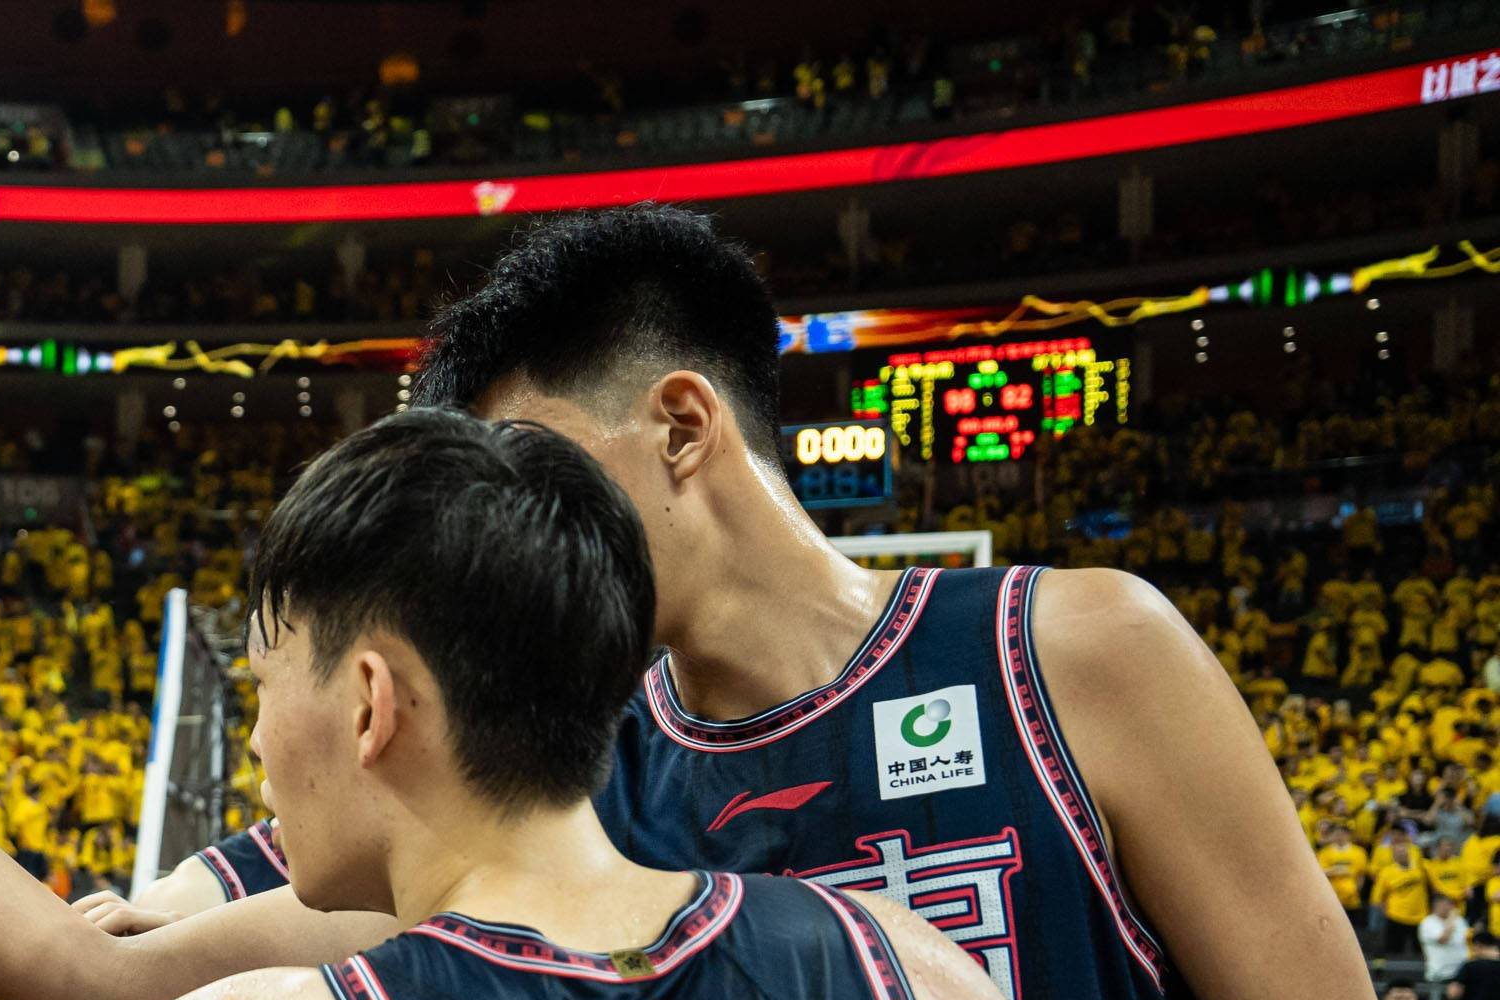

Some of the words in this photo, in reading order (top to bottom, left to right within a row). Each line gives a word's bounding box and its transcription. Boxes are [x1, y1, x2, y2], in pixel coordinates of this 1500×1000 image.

[888, 750, 974, 776] 中国人寿
[889, 773, 937, 788] CHINA
[941, 767, 975, 779] LIFE
